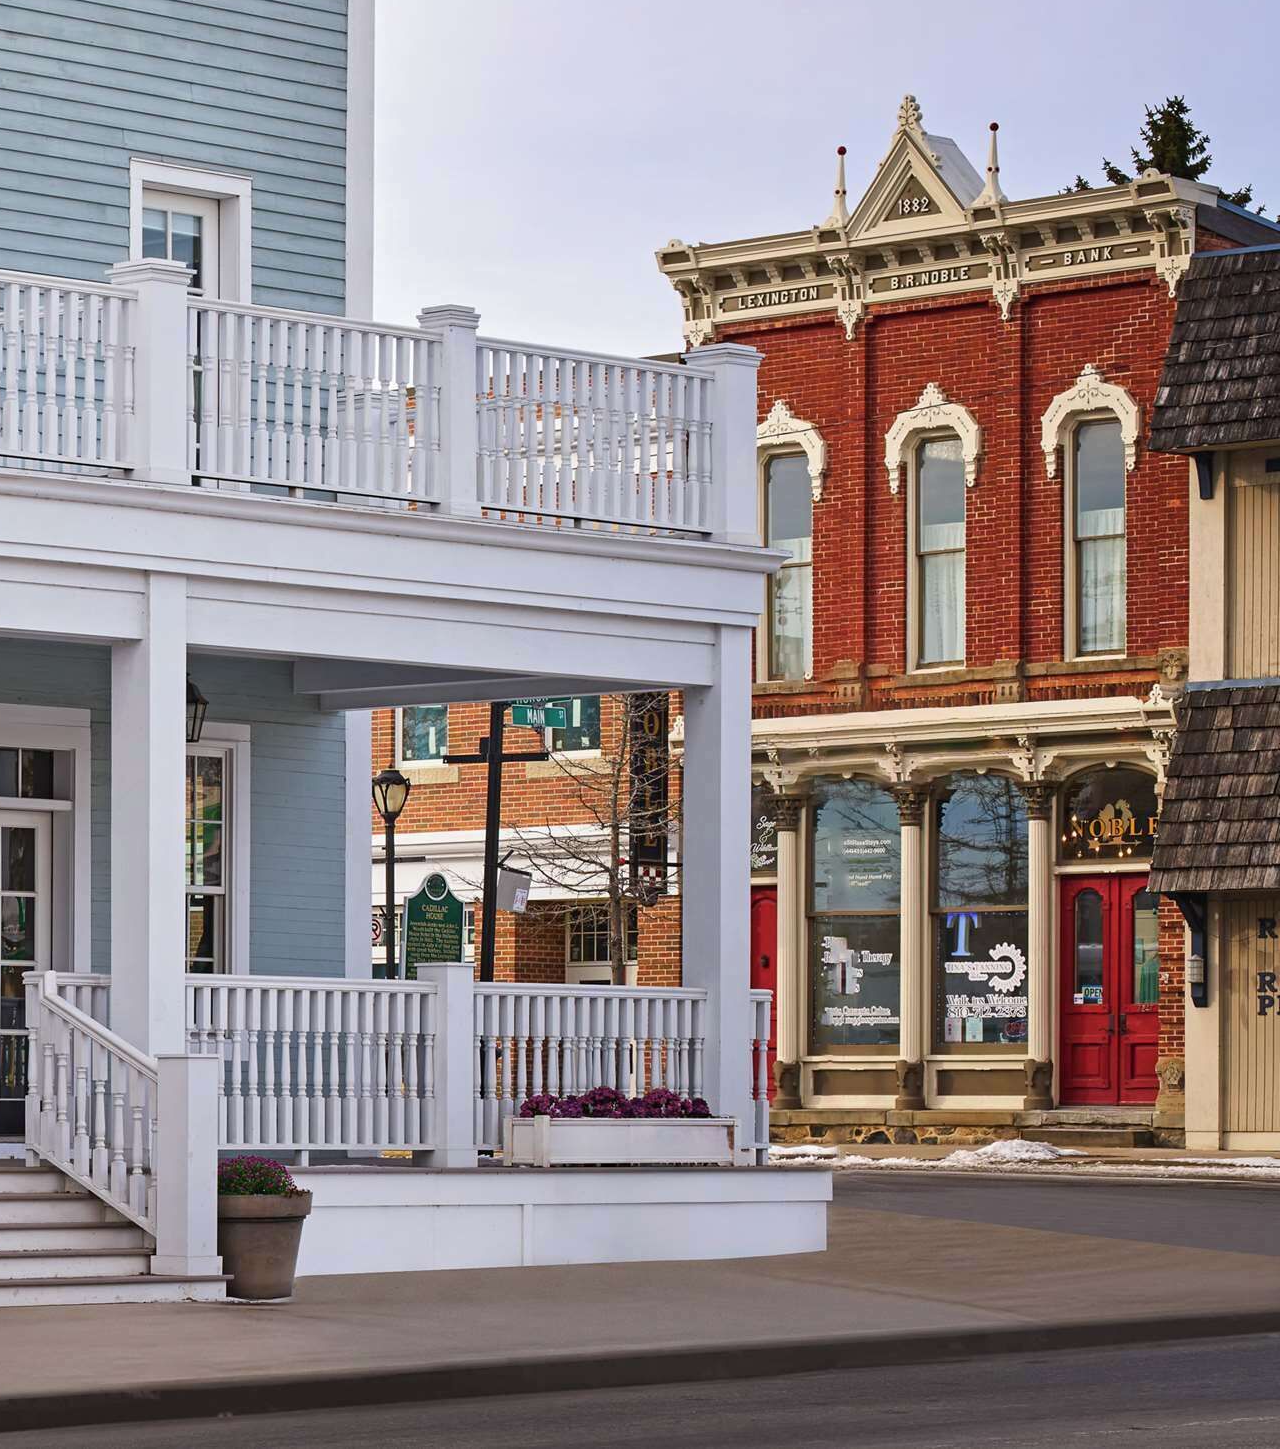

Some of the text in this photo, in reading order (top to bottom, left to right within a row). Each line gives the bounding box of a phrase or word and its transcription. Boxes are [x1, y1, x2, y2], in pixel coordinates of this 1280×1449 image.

[898, 196, 930, 216] 1882
[1064, 247, 1113, 266] BANK
[738, 286, 818, 310] LEXINGTON
[527, 708, 545, 724] MAIN
[986, 994, 1027, 1006] Welcome
[1257, 995, 1280, 1016] P
